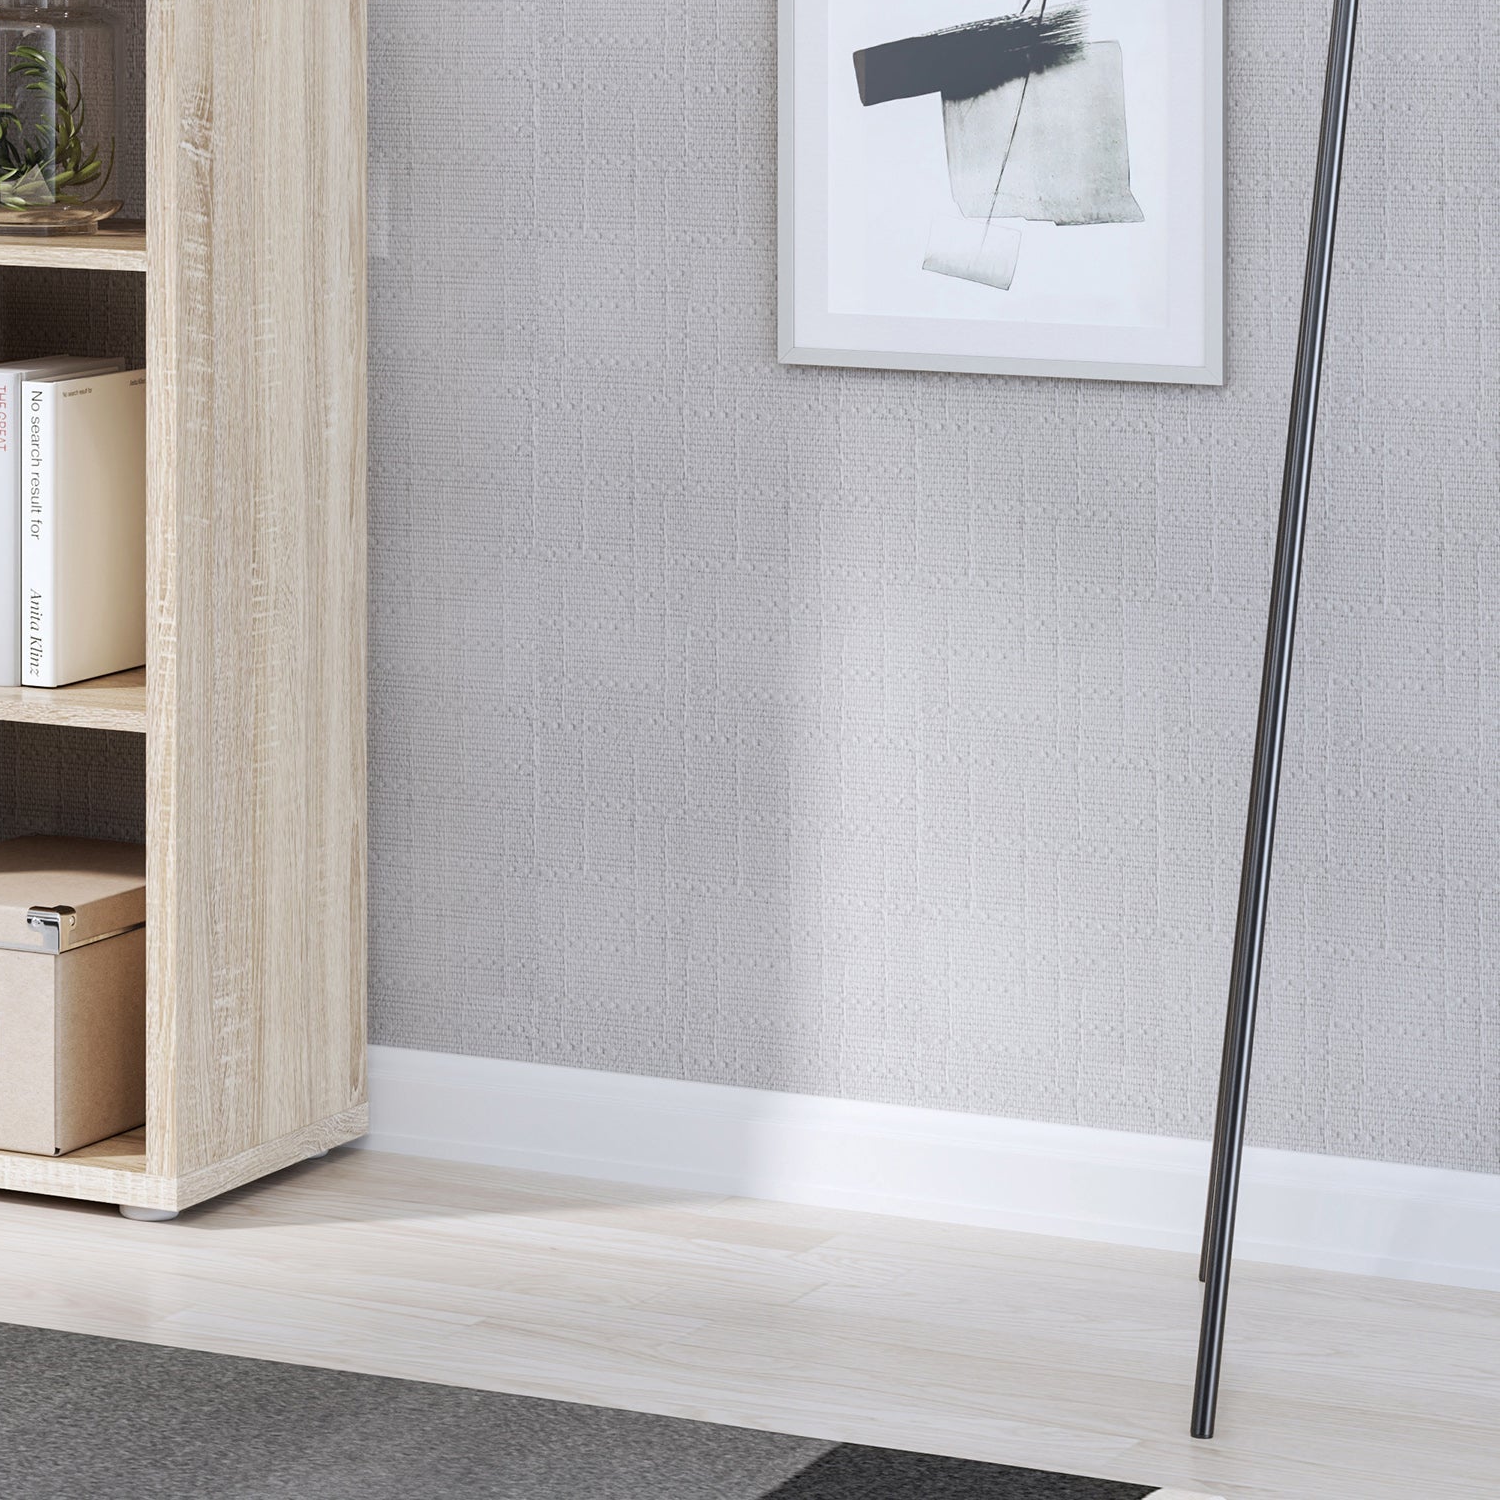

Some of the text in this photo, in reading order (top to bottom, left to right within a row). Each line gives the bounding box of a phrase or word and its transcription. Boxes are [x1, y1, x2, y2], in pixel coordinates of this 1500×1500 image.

[30, 390, 43, 540] No search result for
[30, 588, 43, 677] Anita Klinz
